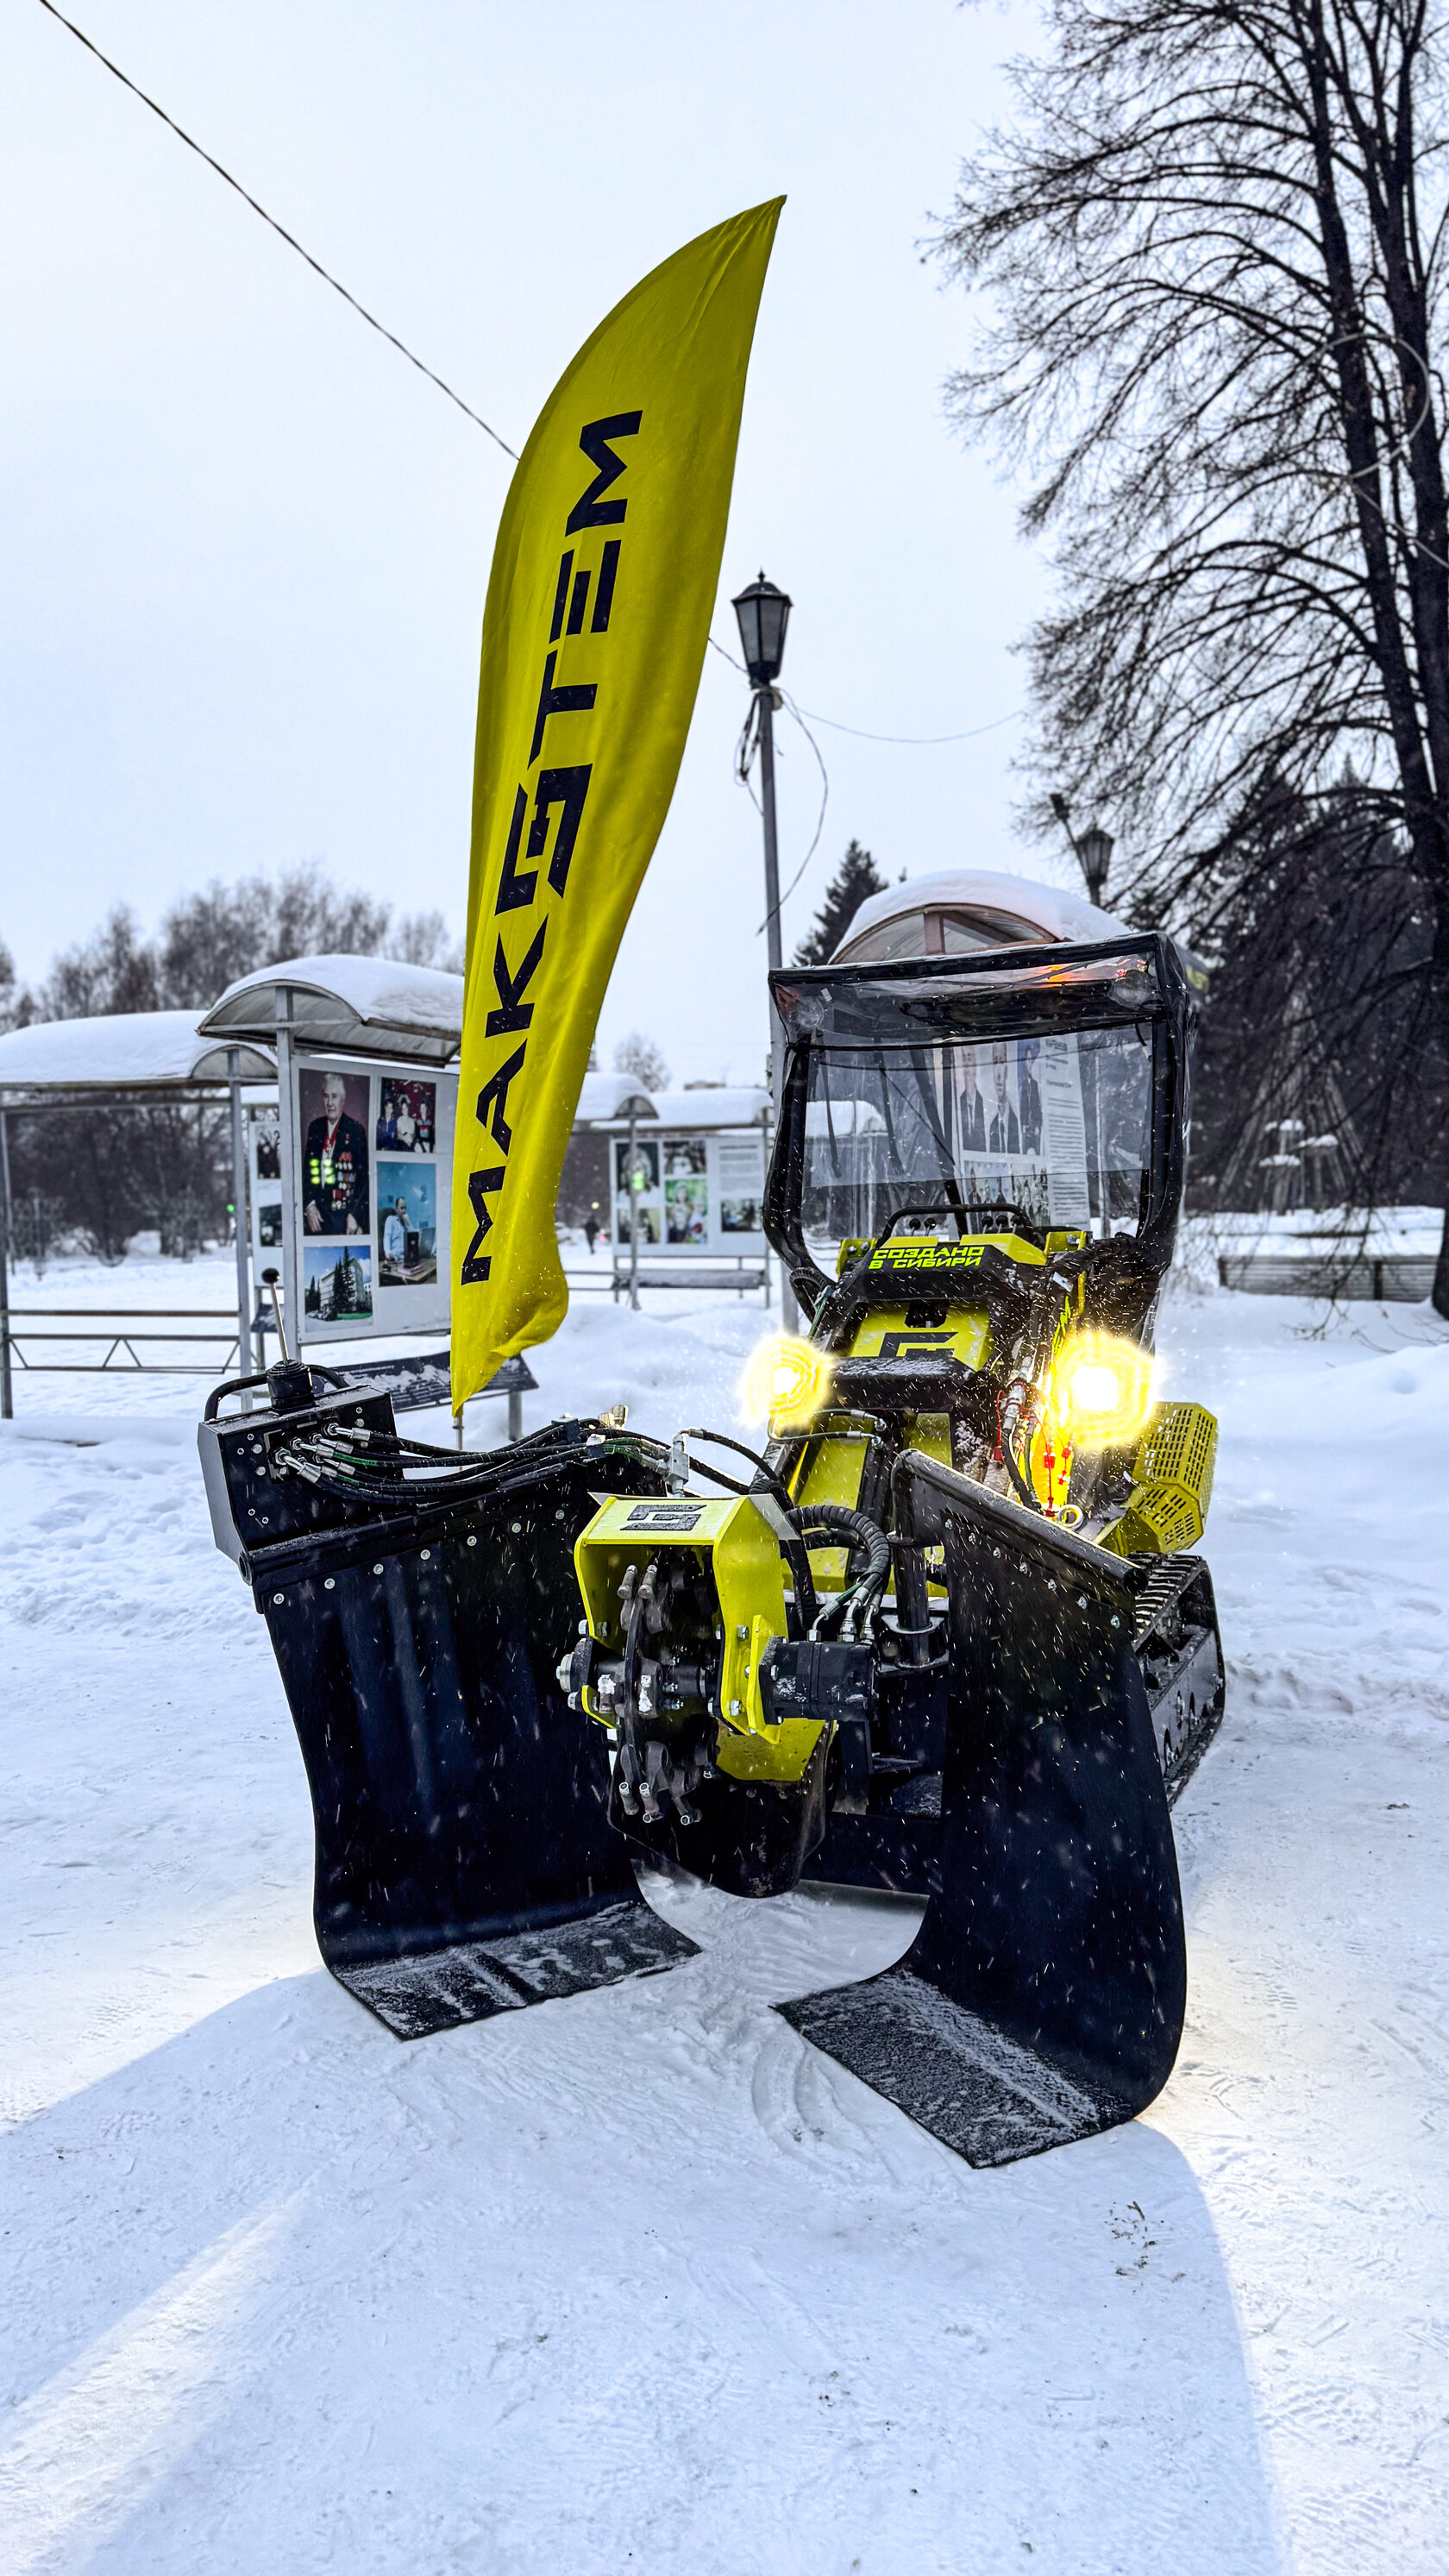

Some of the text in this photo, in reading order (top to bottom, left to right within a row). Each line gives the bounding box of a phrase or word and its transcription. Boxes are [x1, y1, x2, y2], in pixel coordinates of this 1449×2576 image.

[872, 1247, 985, 1259] СОЗДАНО
[868, 1257, 982, 1270] В СИБИРИ
